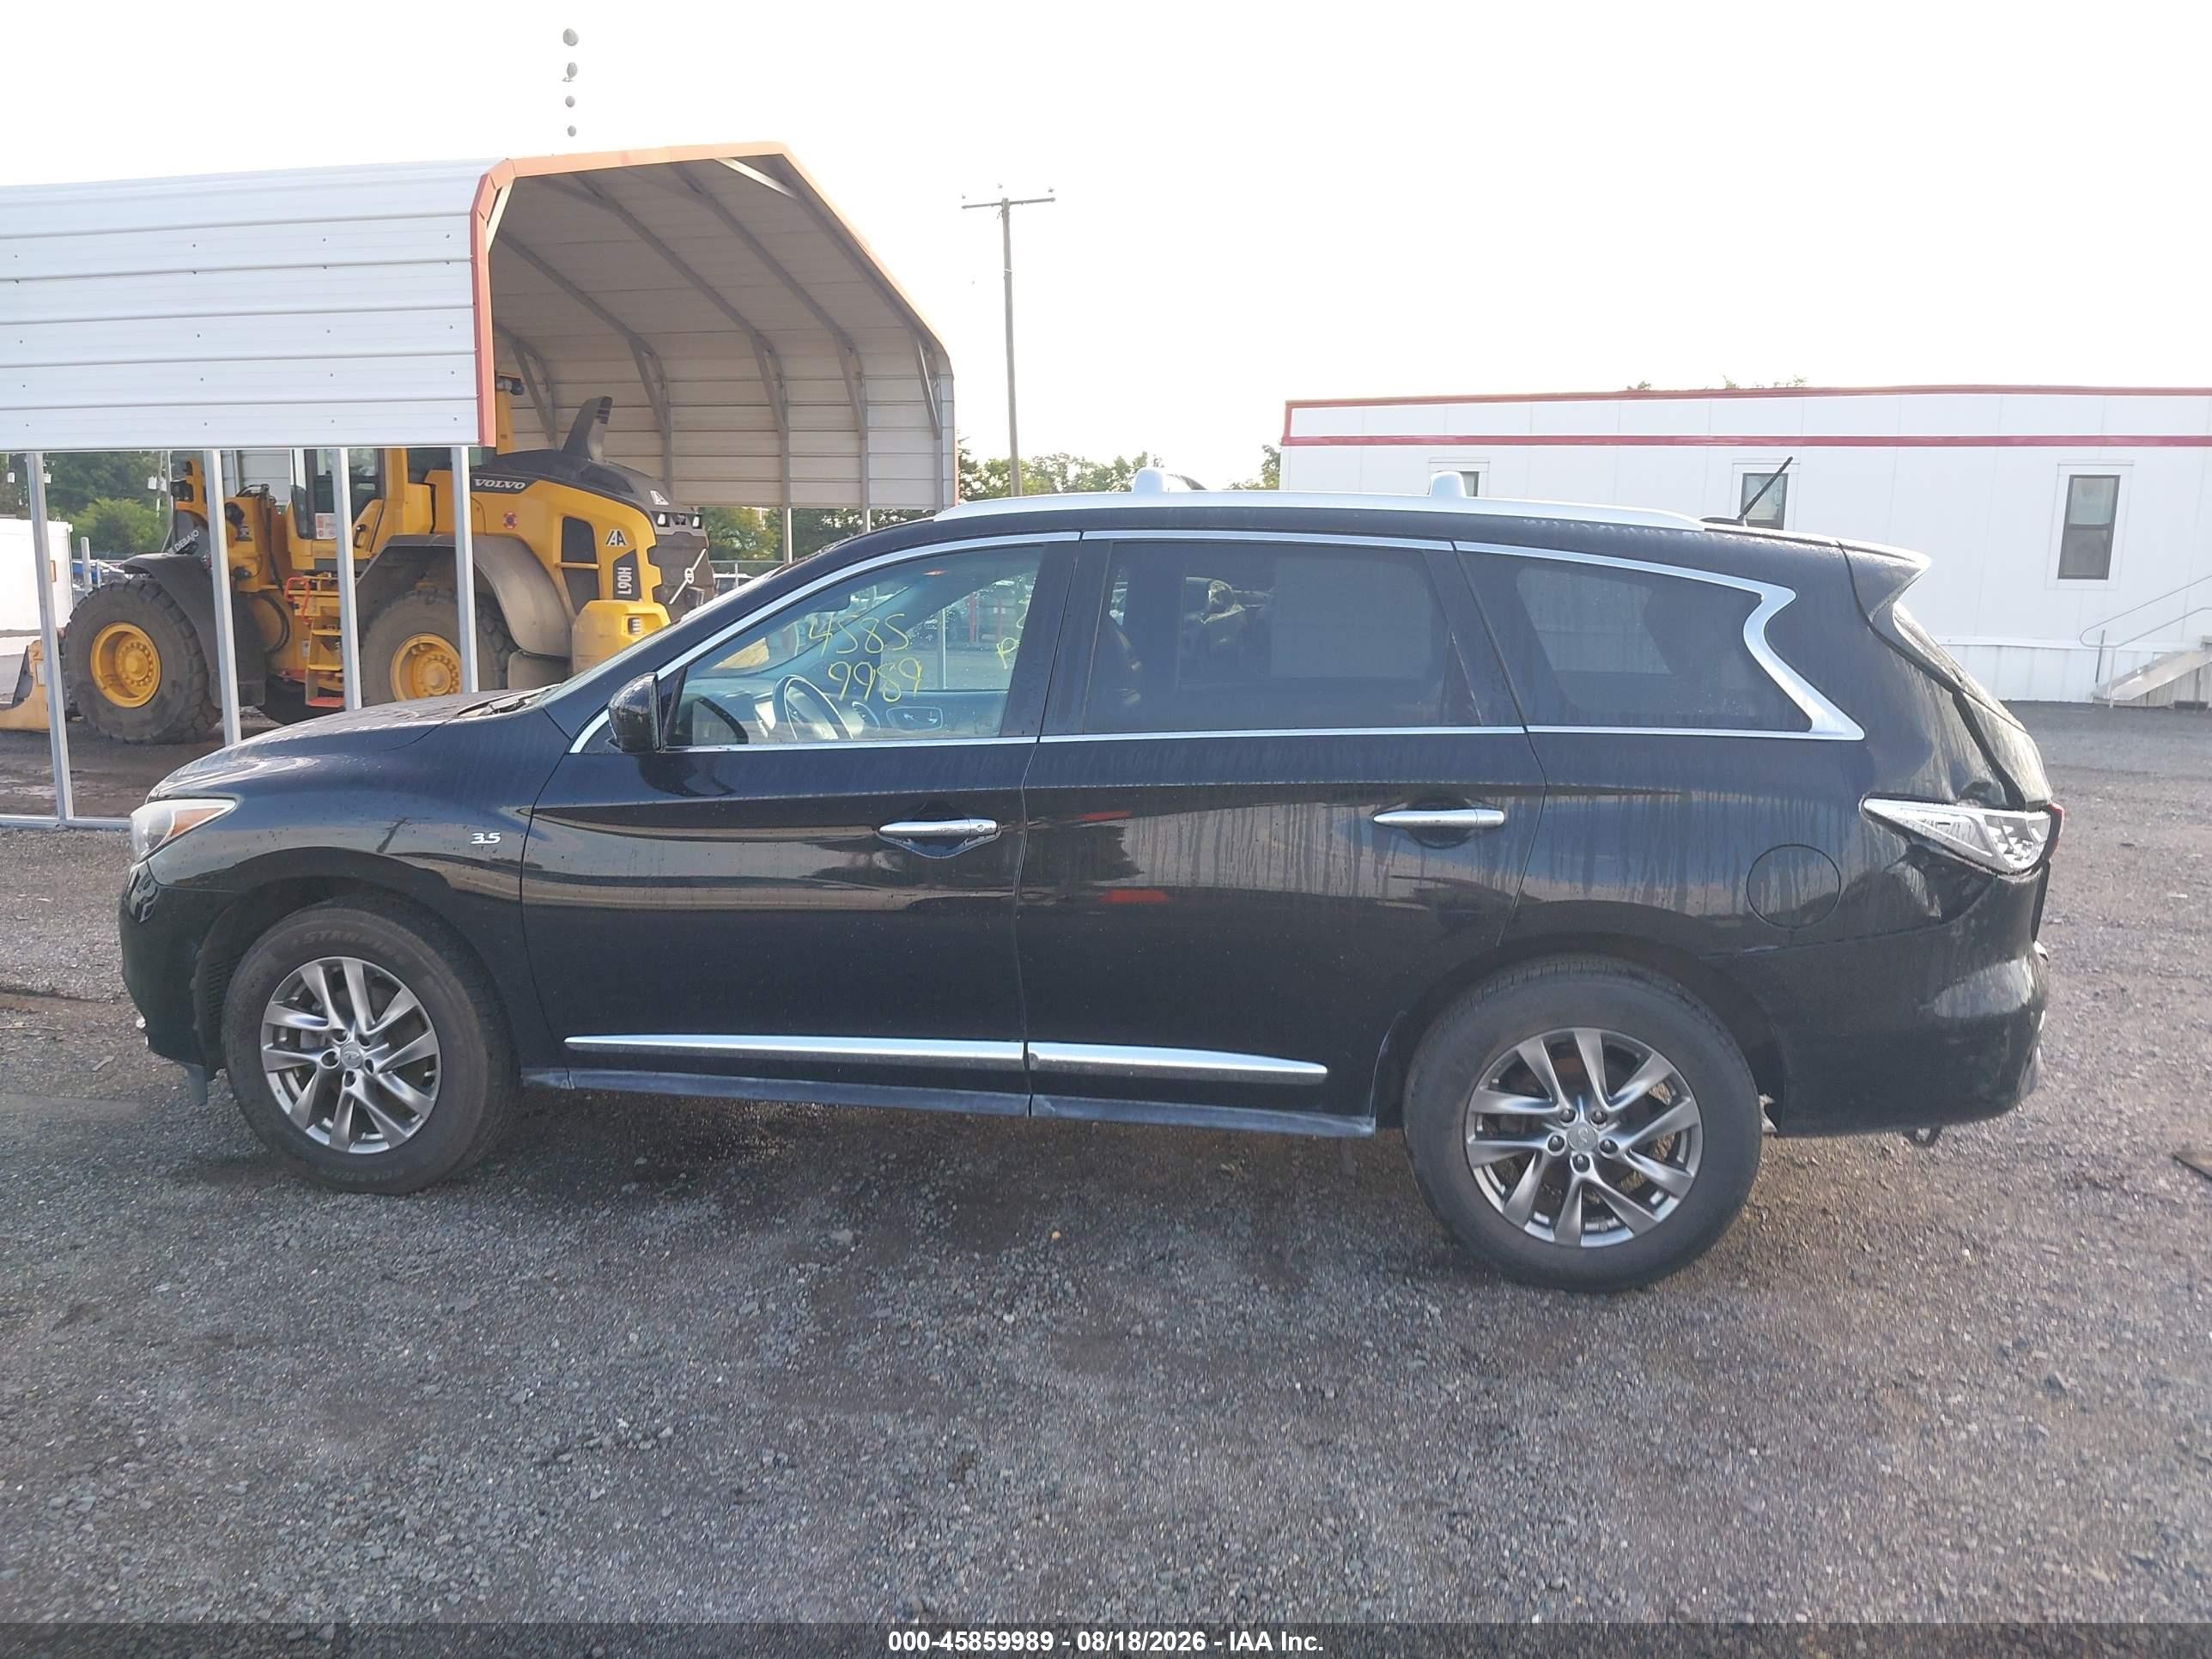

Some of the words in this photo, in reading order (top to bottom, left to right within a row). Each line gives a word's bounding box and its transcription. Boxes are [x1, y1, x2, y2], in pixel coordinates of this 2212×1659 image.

[473, 478, 526, 489] VOLVO
[617, 567, 633, 595] L90H
[808, 613, 910, 659] 4585
[828, 657, 923, 702] 9989
